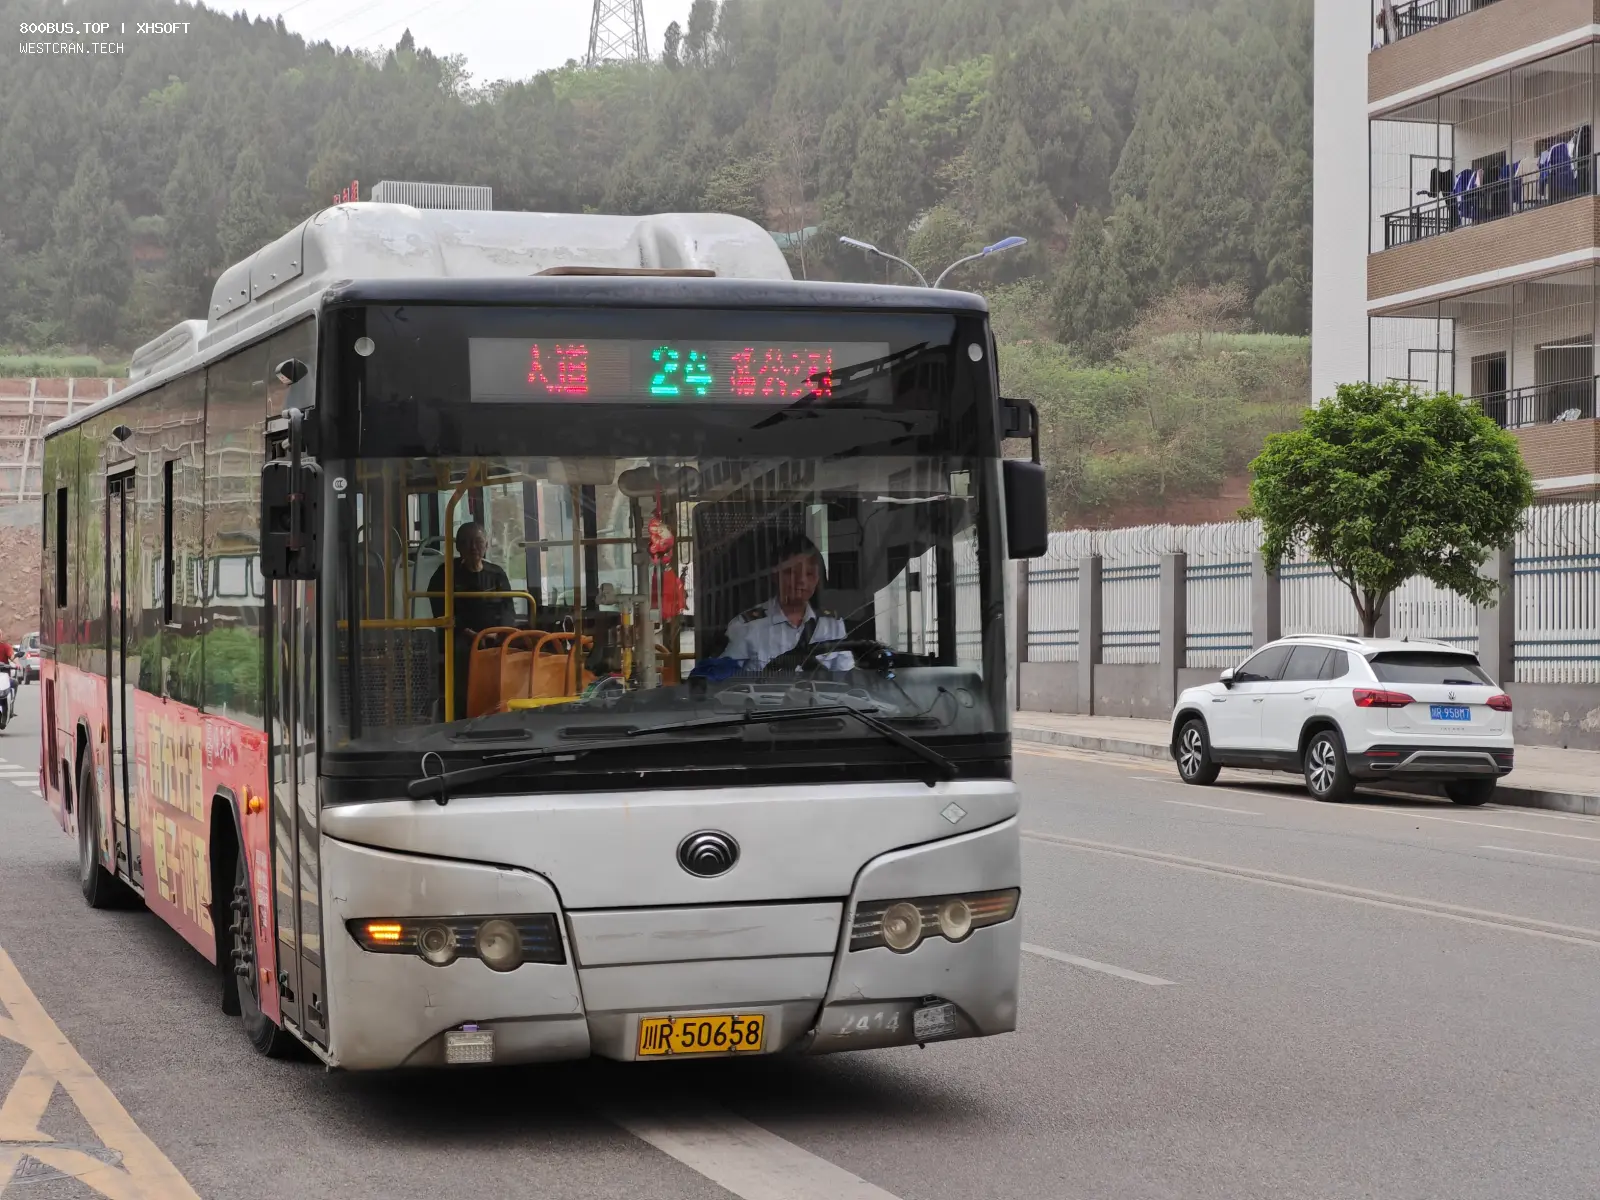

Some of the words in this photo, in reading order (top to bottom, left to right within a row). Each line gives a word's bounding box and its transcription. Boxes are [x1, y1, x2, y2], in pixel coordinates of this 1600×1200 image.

[647, 345, 713, 398] 24
[642, 1020, 760, 1050] 川R·50658
[840, 1011, 900, 1033] 2414
